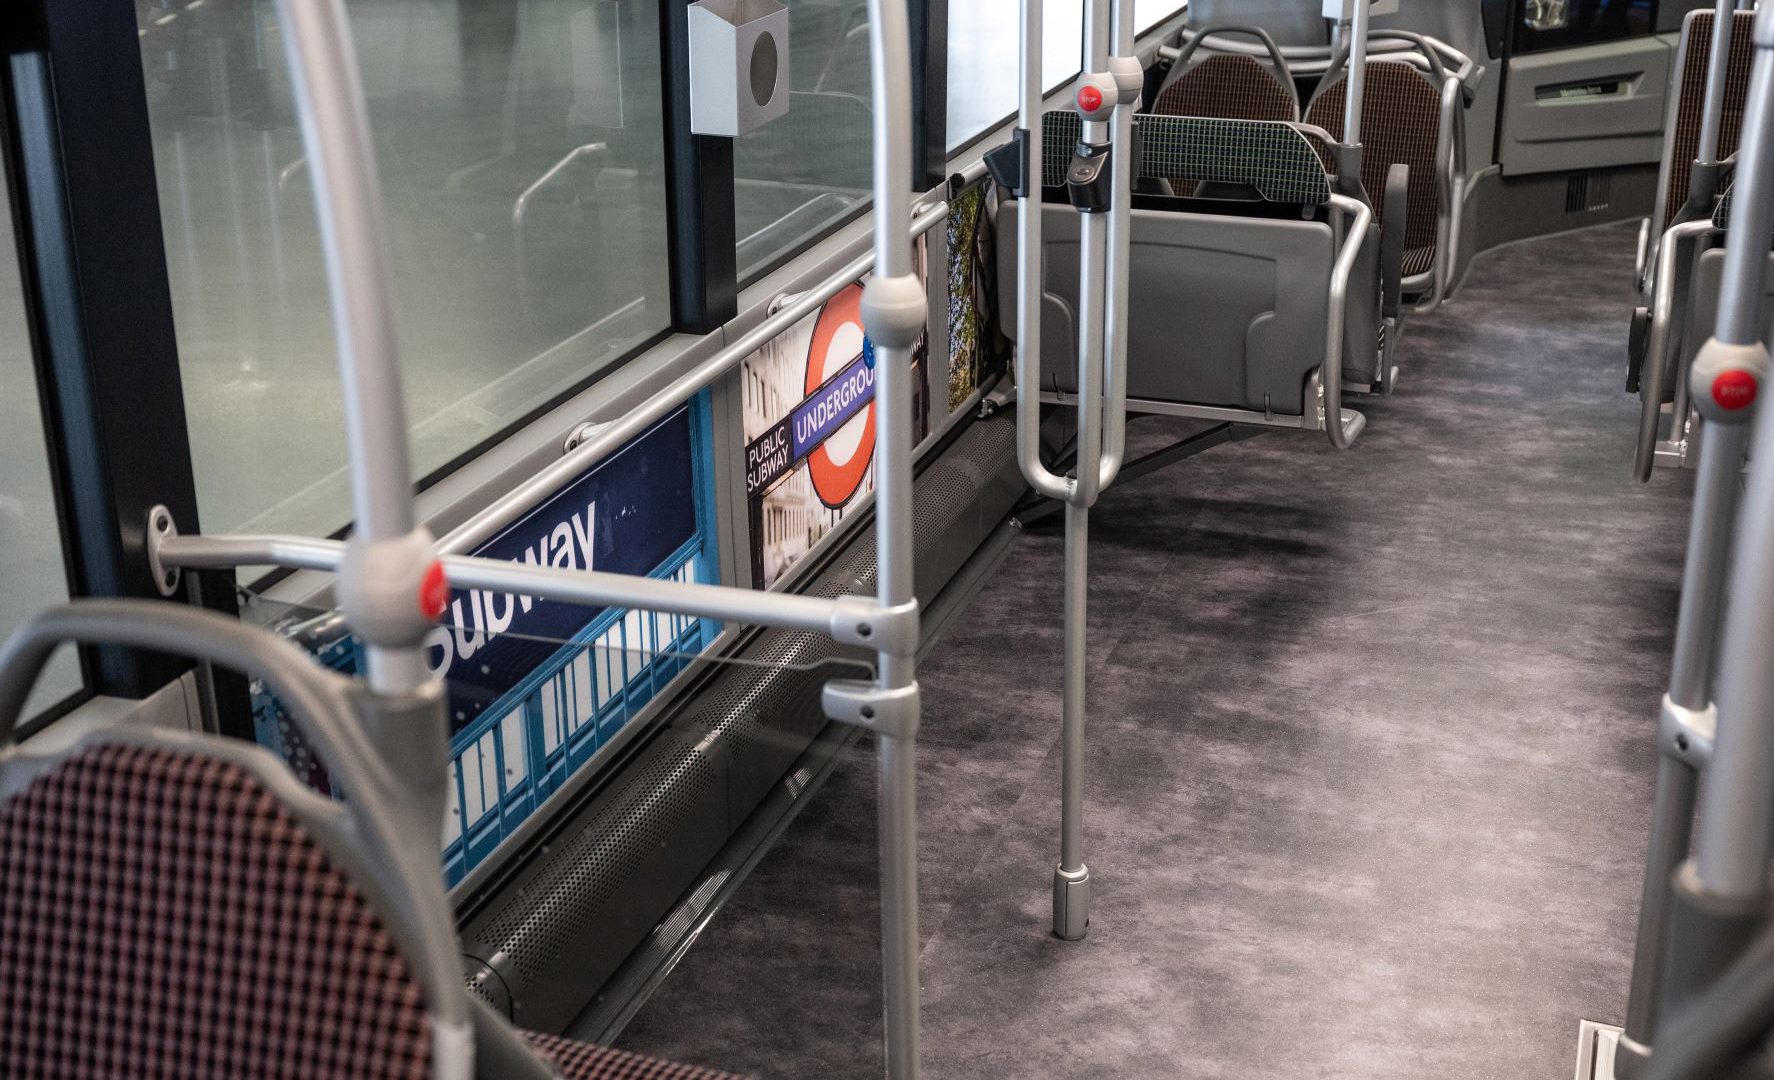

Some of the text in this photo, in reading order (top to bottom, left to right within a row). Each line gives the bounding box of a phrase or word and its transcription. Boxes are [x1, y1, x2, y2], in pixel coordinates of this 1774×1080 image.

[797, 365, 877, 444] UNDERGROU
[747, 445, 789, 493] SUBWAY
[750, 426, 785, 469] PUBLIC
